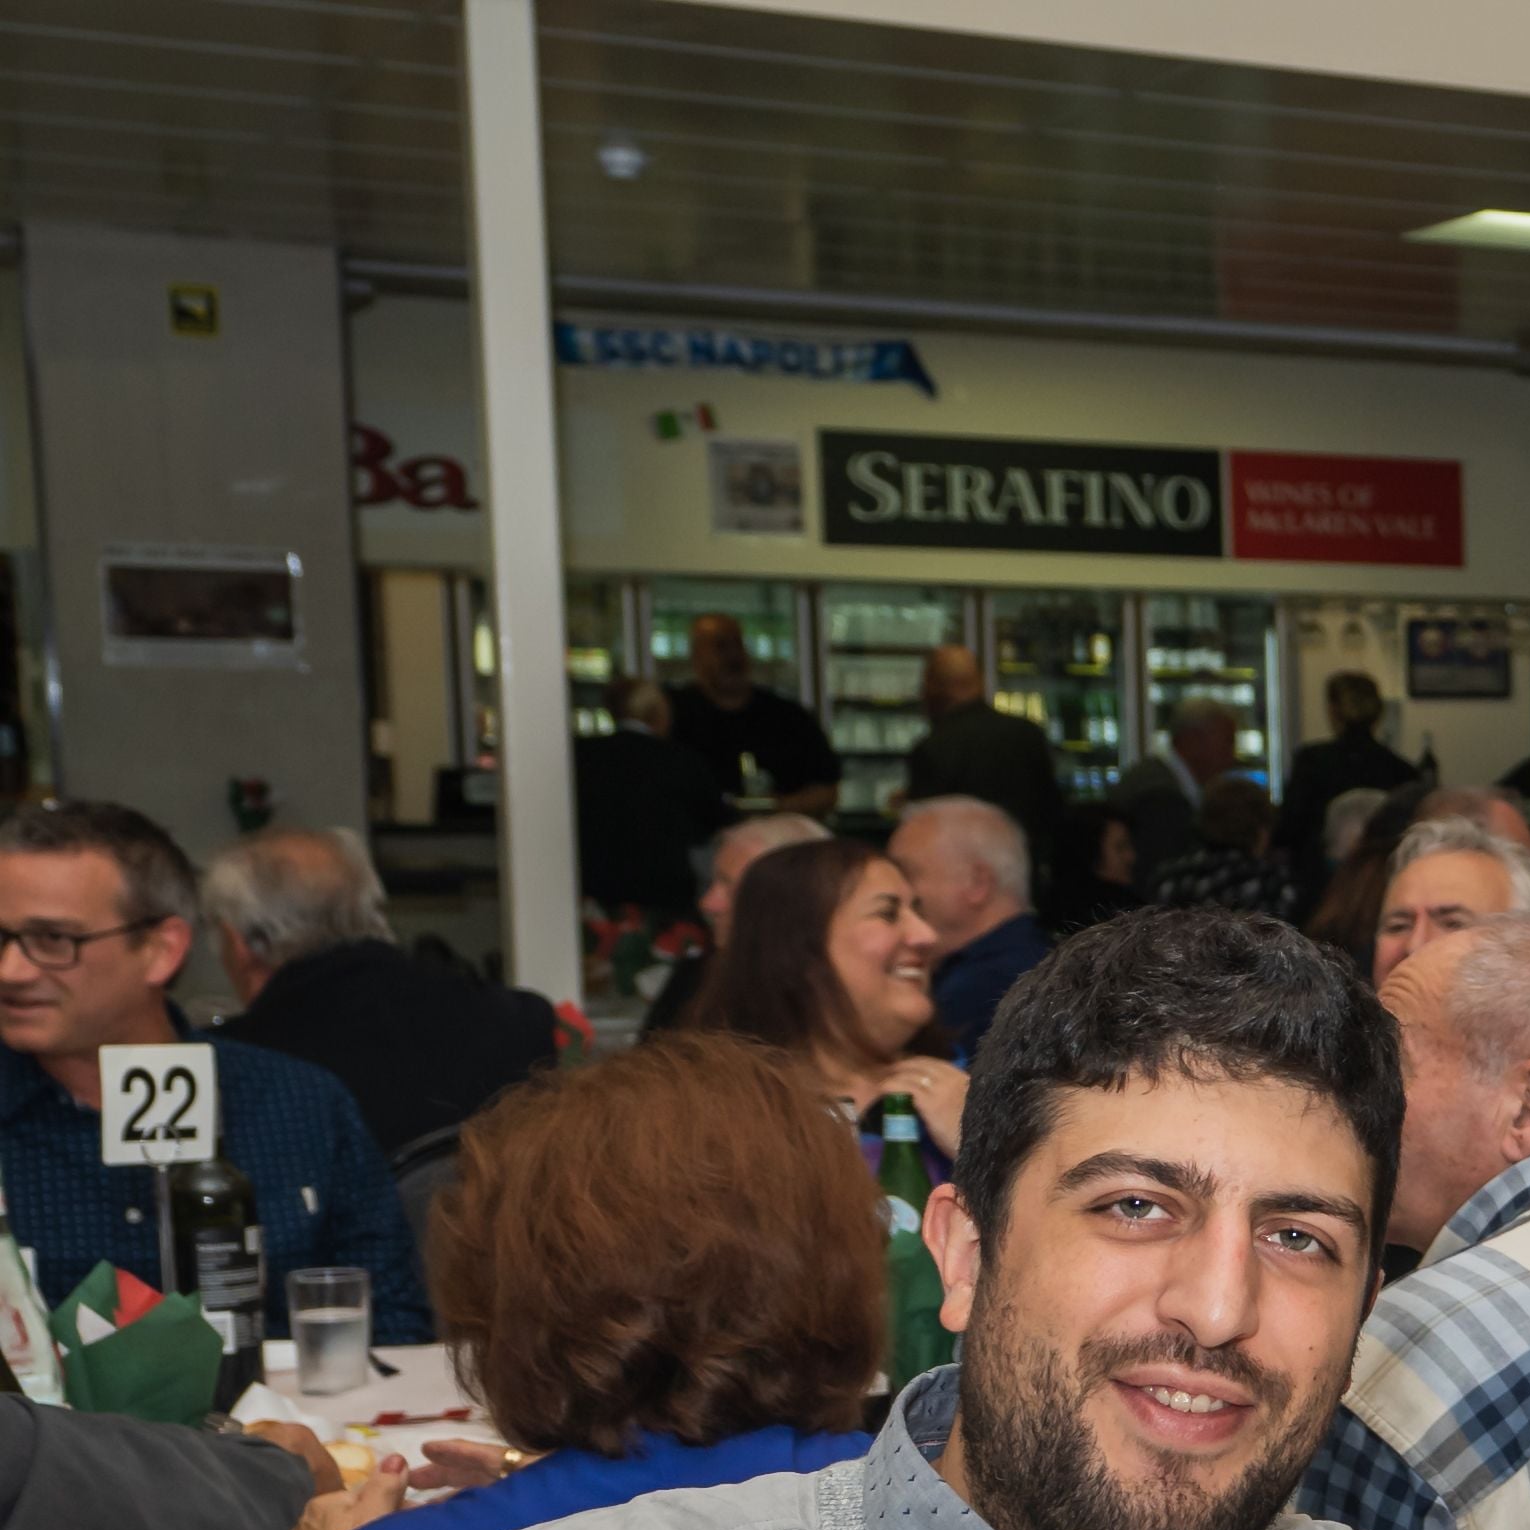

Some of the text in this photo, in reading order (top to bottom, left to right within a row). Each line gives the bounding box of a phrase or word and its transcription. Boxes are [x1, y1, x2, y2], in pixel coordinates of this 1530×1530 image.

[1245, 480, 1375, 509] WINES OF
[121, 1066, 197, 1141] 22
